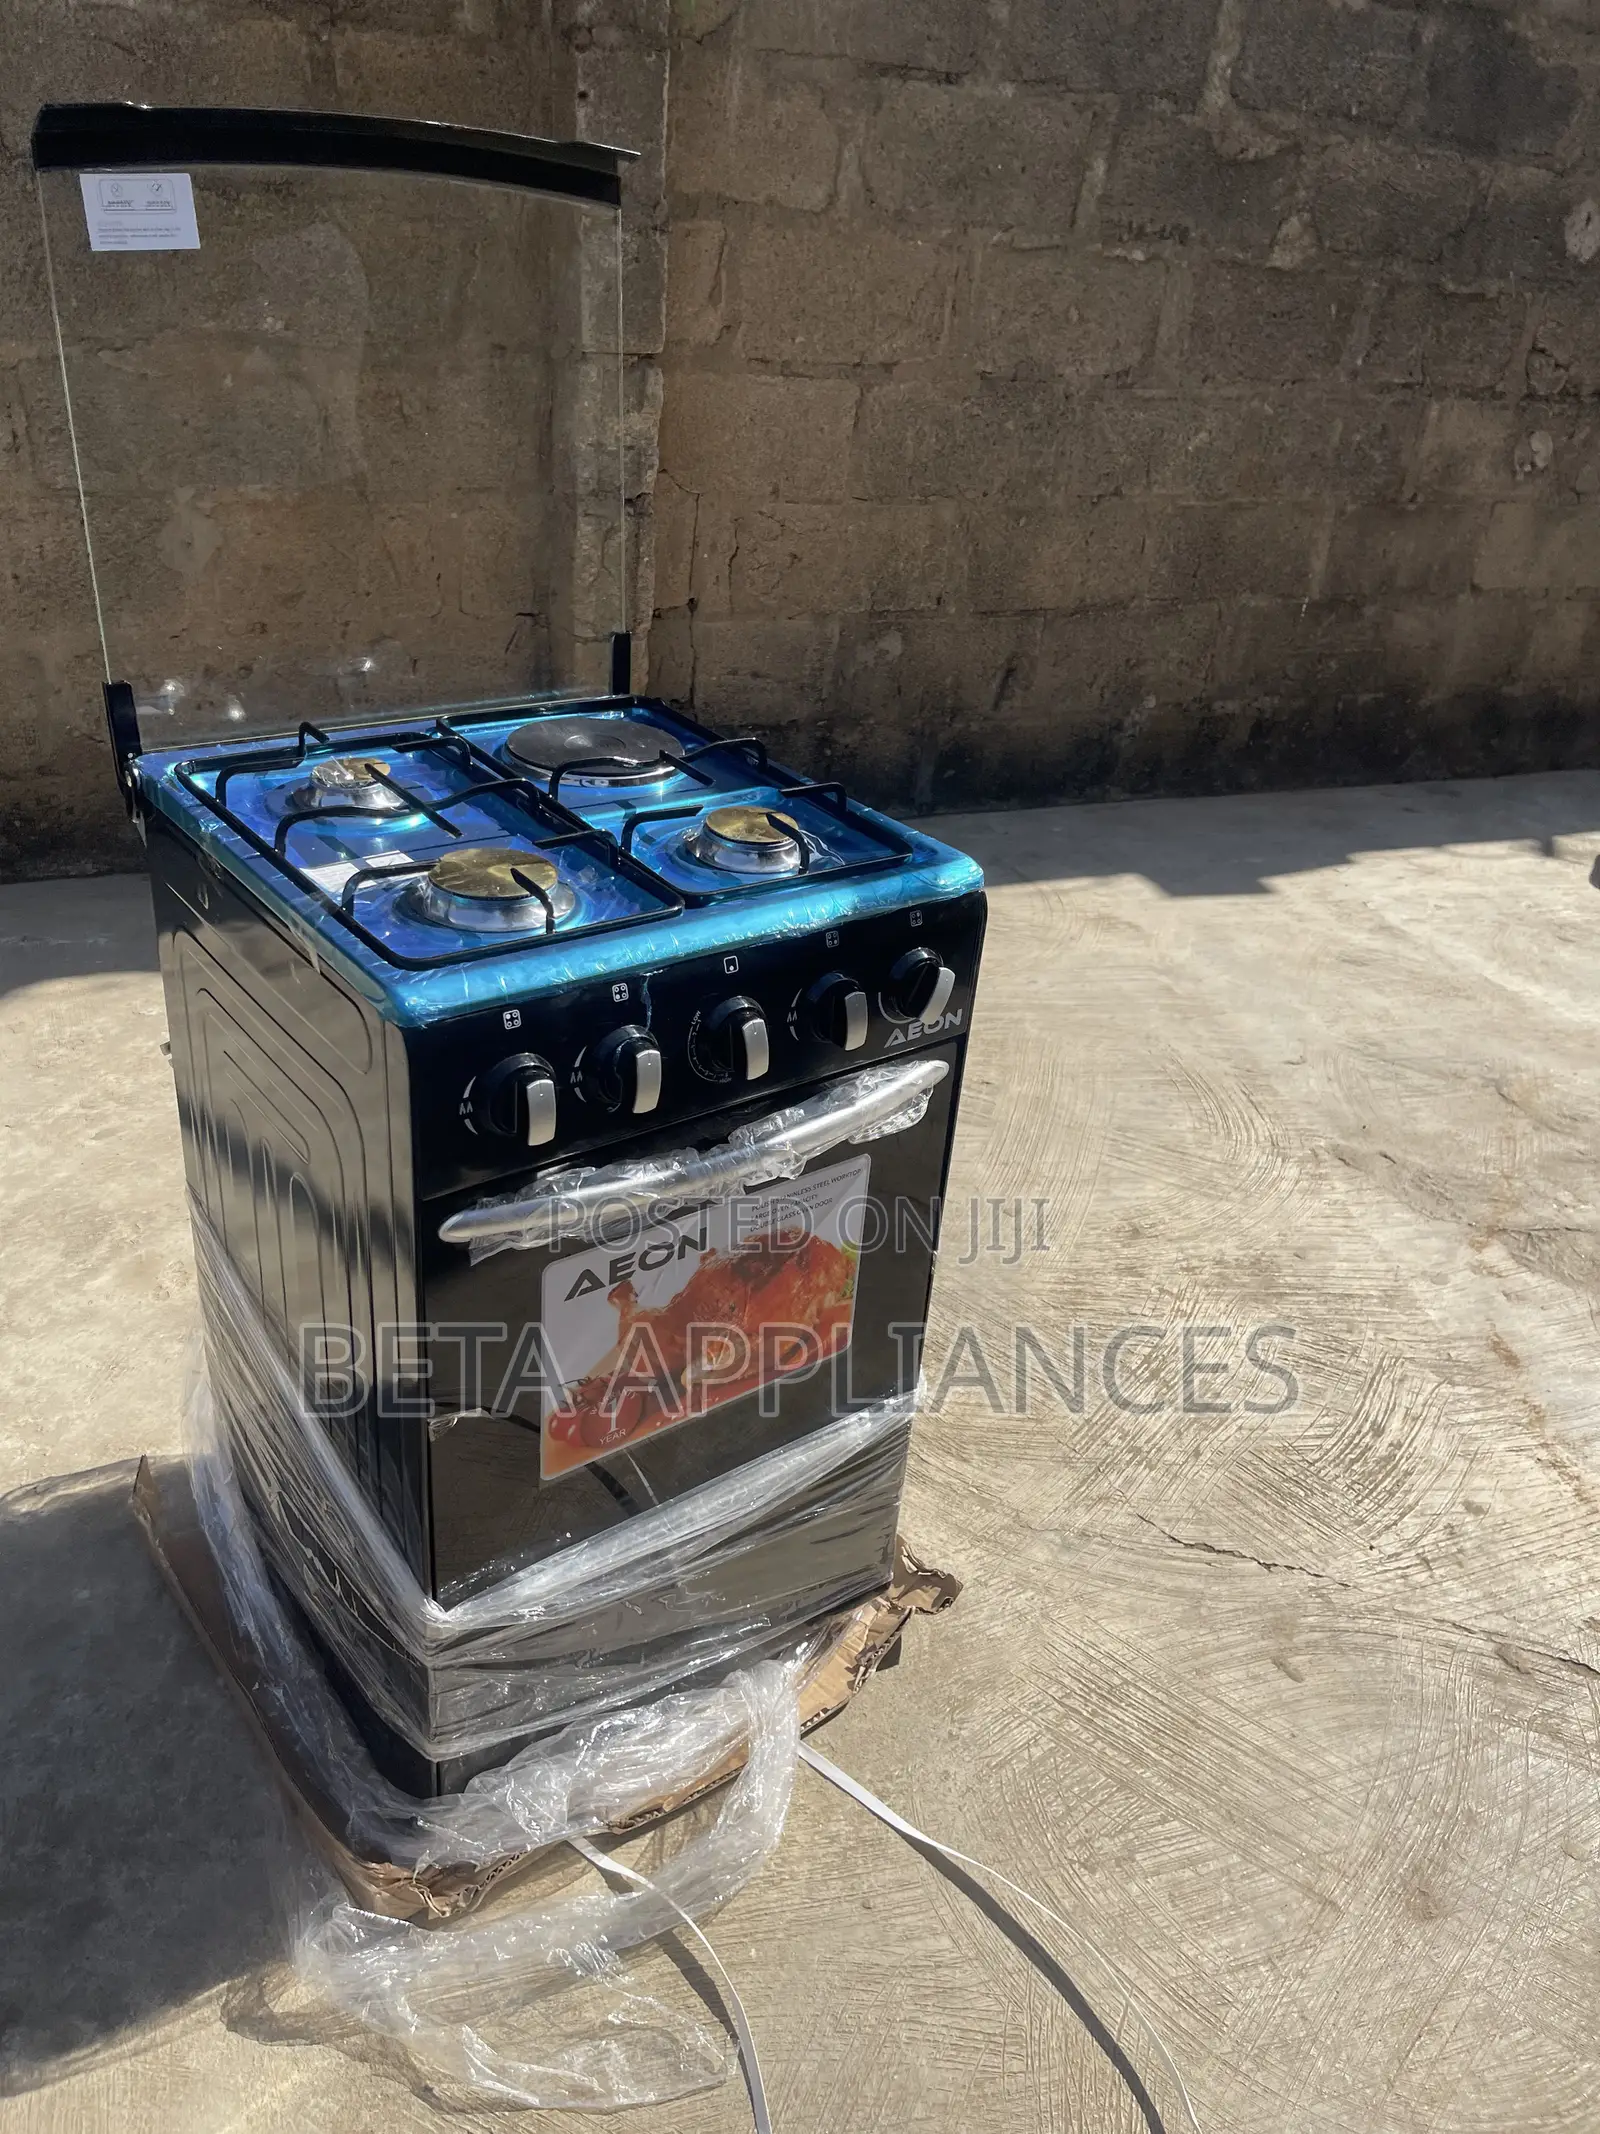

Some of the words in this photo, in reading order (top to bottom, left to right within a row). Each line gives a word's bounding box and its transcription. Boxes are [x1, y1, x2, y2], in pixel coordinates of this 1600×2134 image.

[691, 1010, 701, 1025] LOW
[884, 1008, 963, 1049] AEON
[812, 1180, 831, 1191] STEEL
[831, 1168, 862, 1184] WORKTOP
[814, 1197, 833, 1209] DOOR
[564, 1227, 708, 1301] AEON
[600, 1428, 627, 1444] YEAR
